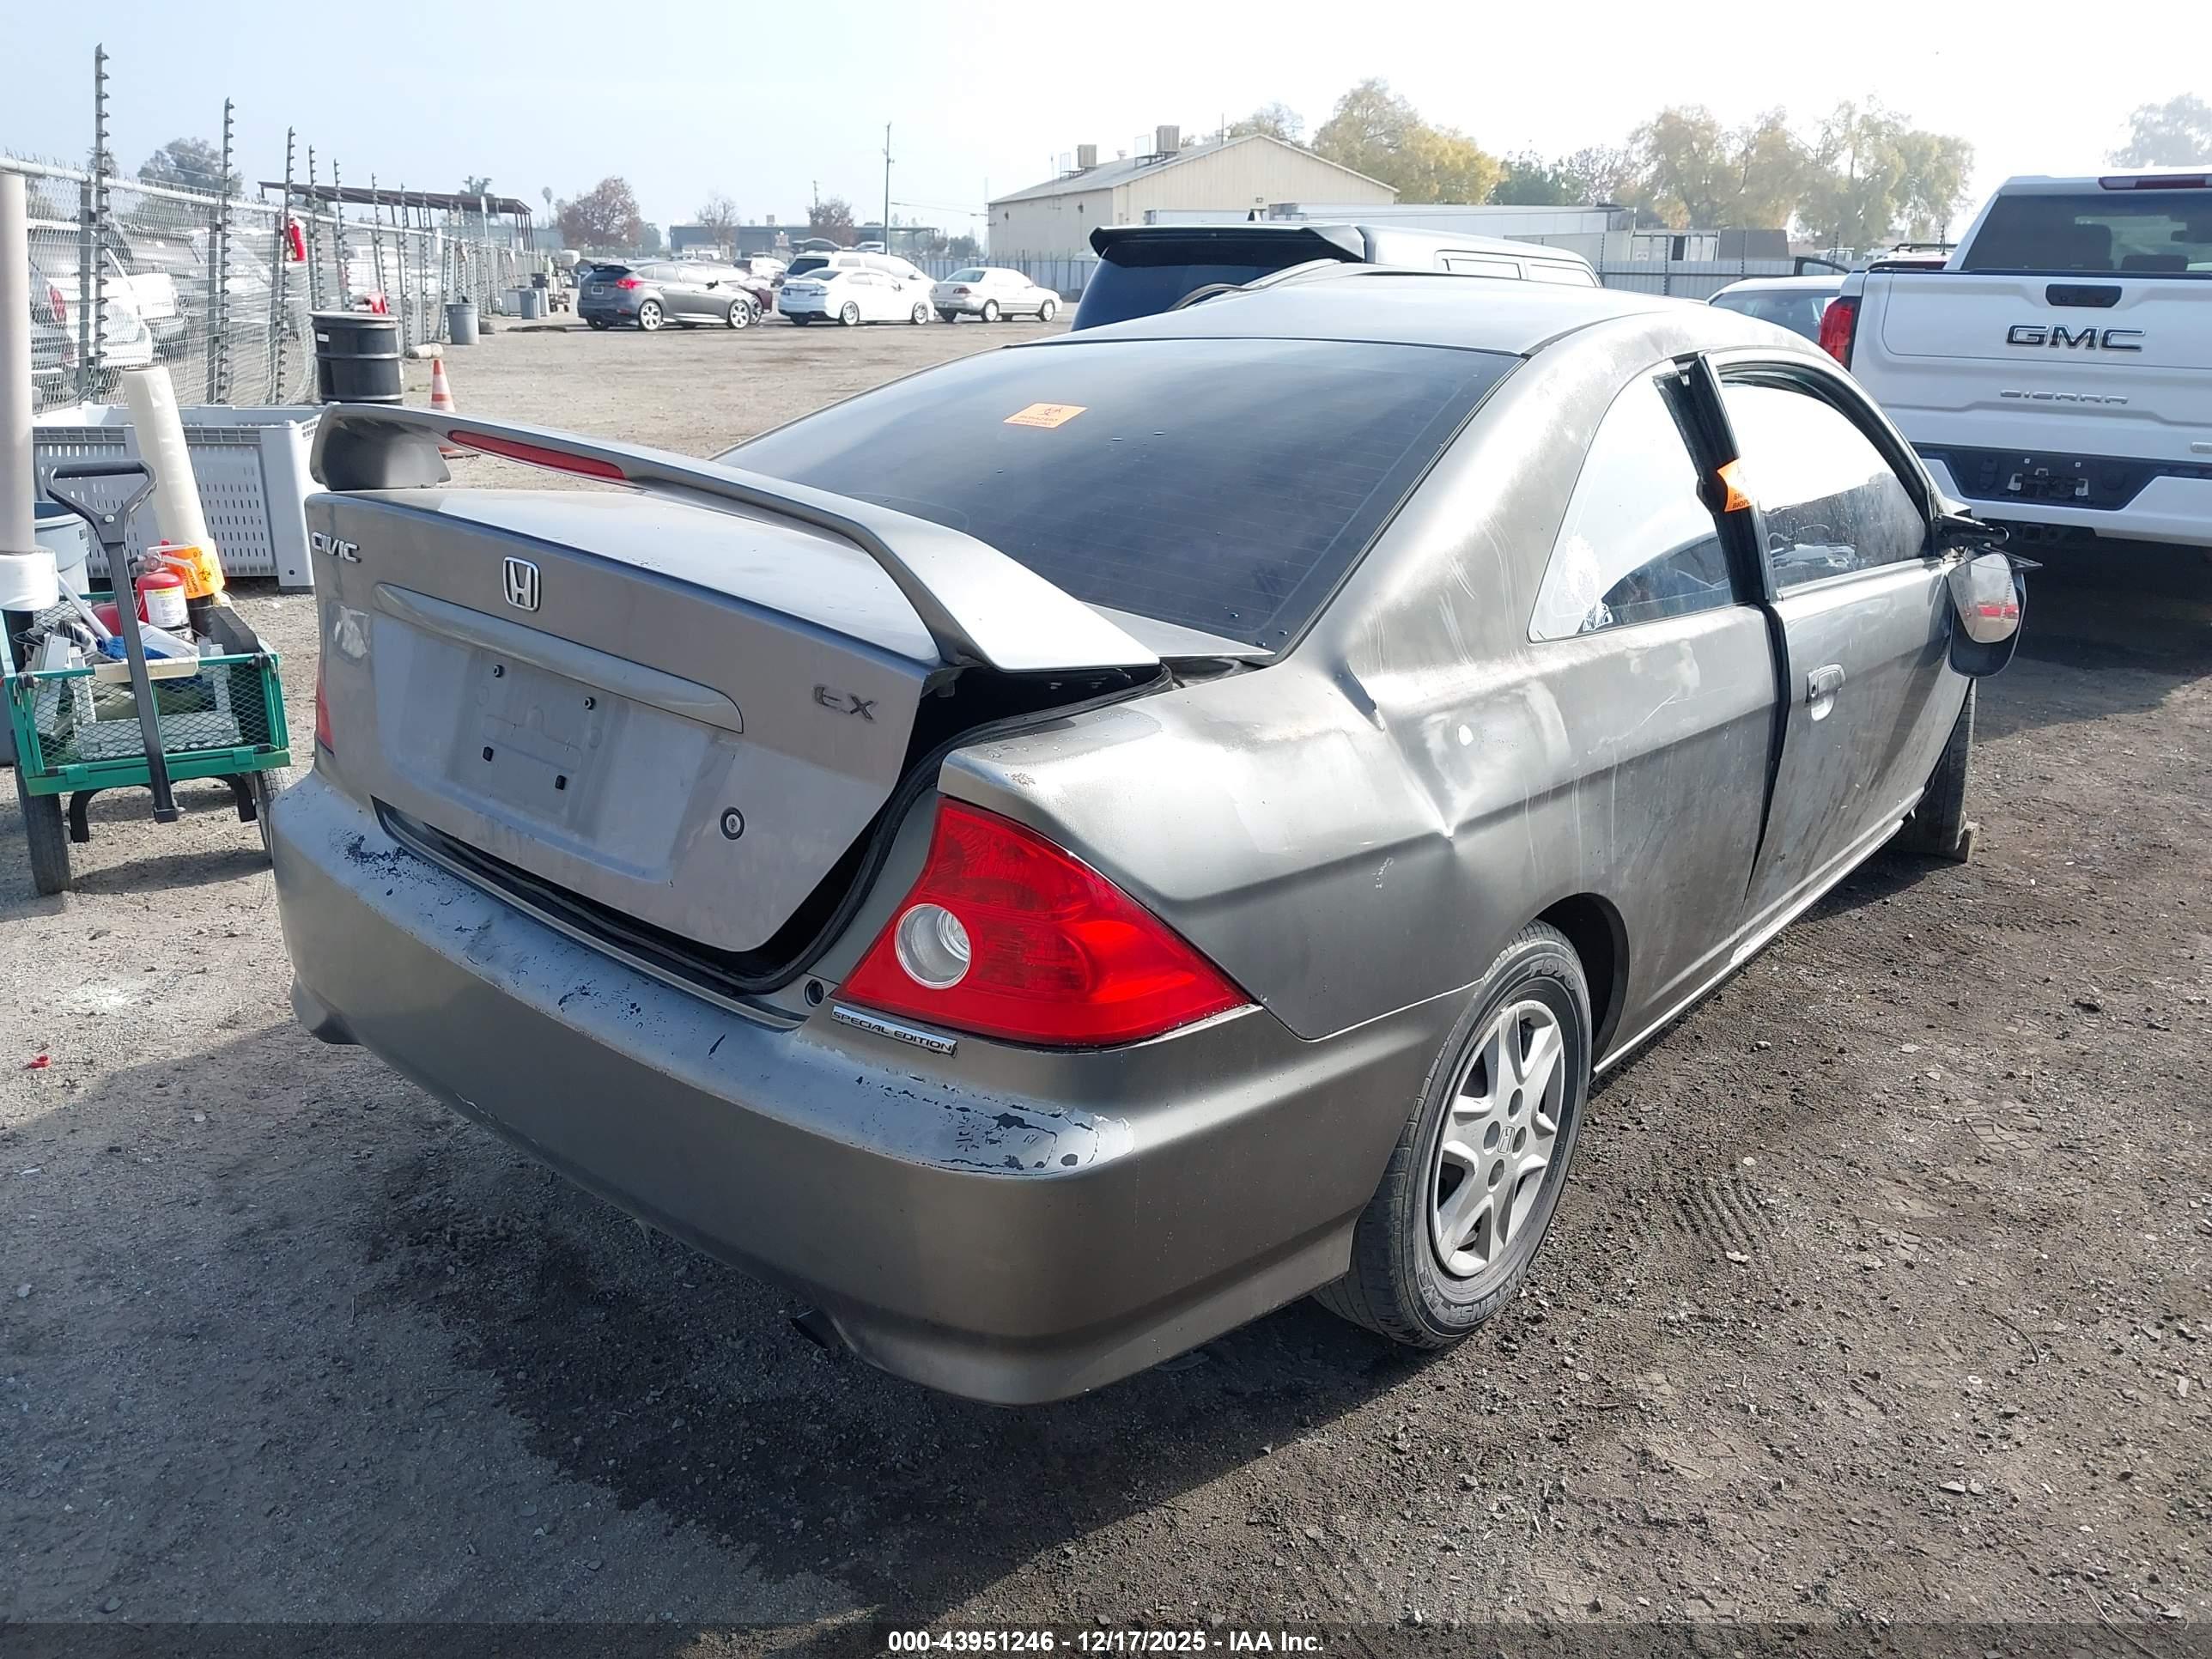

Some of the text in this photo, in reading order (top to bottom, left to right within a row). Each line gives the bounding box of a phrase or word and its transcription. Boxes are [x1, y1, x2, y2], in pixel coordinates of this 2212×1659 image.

[2007, 324, 2145, 352] GMC
[2000, 390, 2129, 404] SIERRA
[311, 531, 360, 563] CIVIC
[812, 685, 875, 721] EX
[1528, 958, 1579, 991] TOYO
[833, 1011, 952, 1052] SPECIAL EDITION
